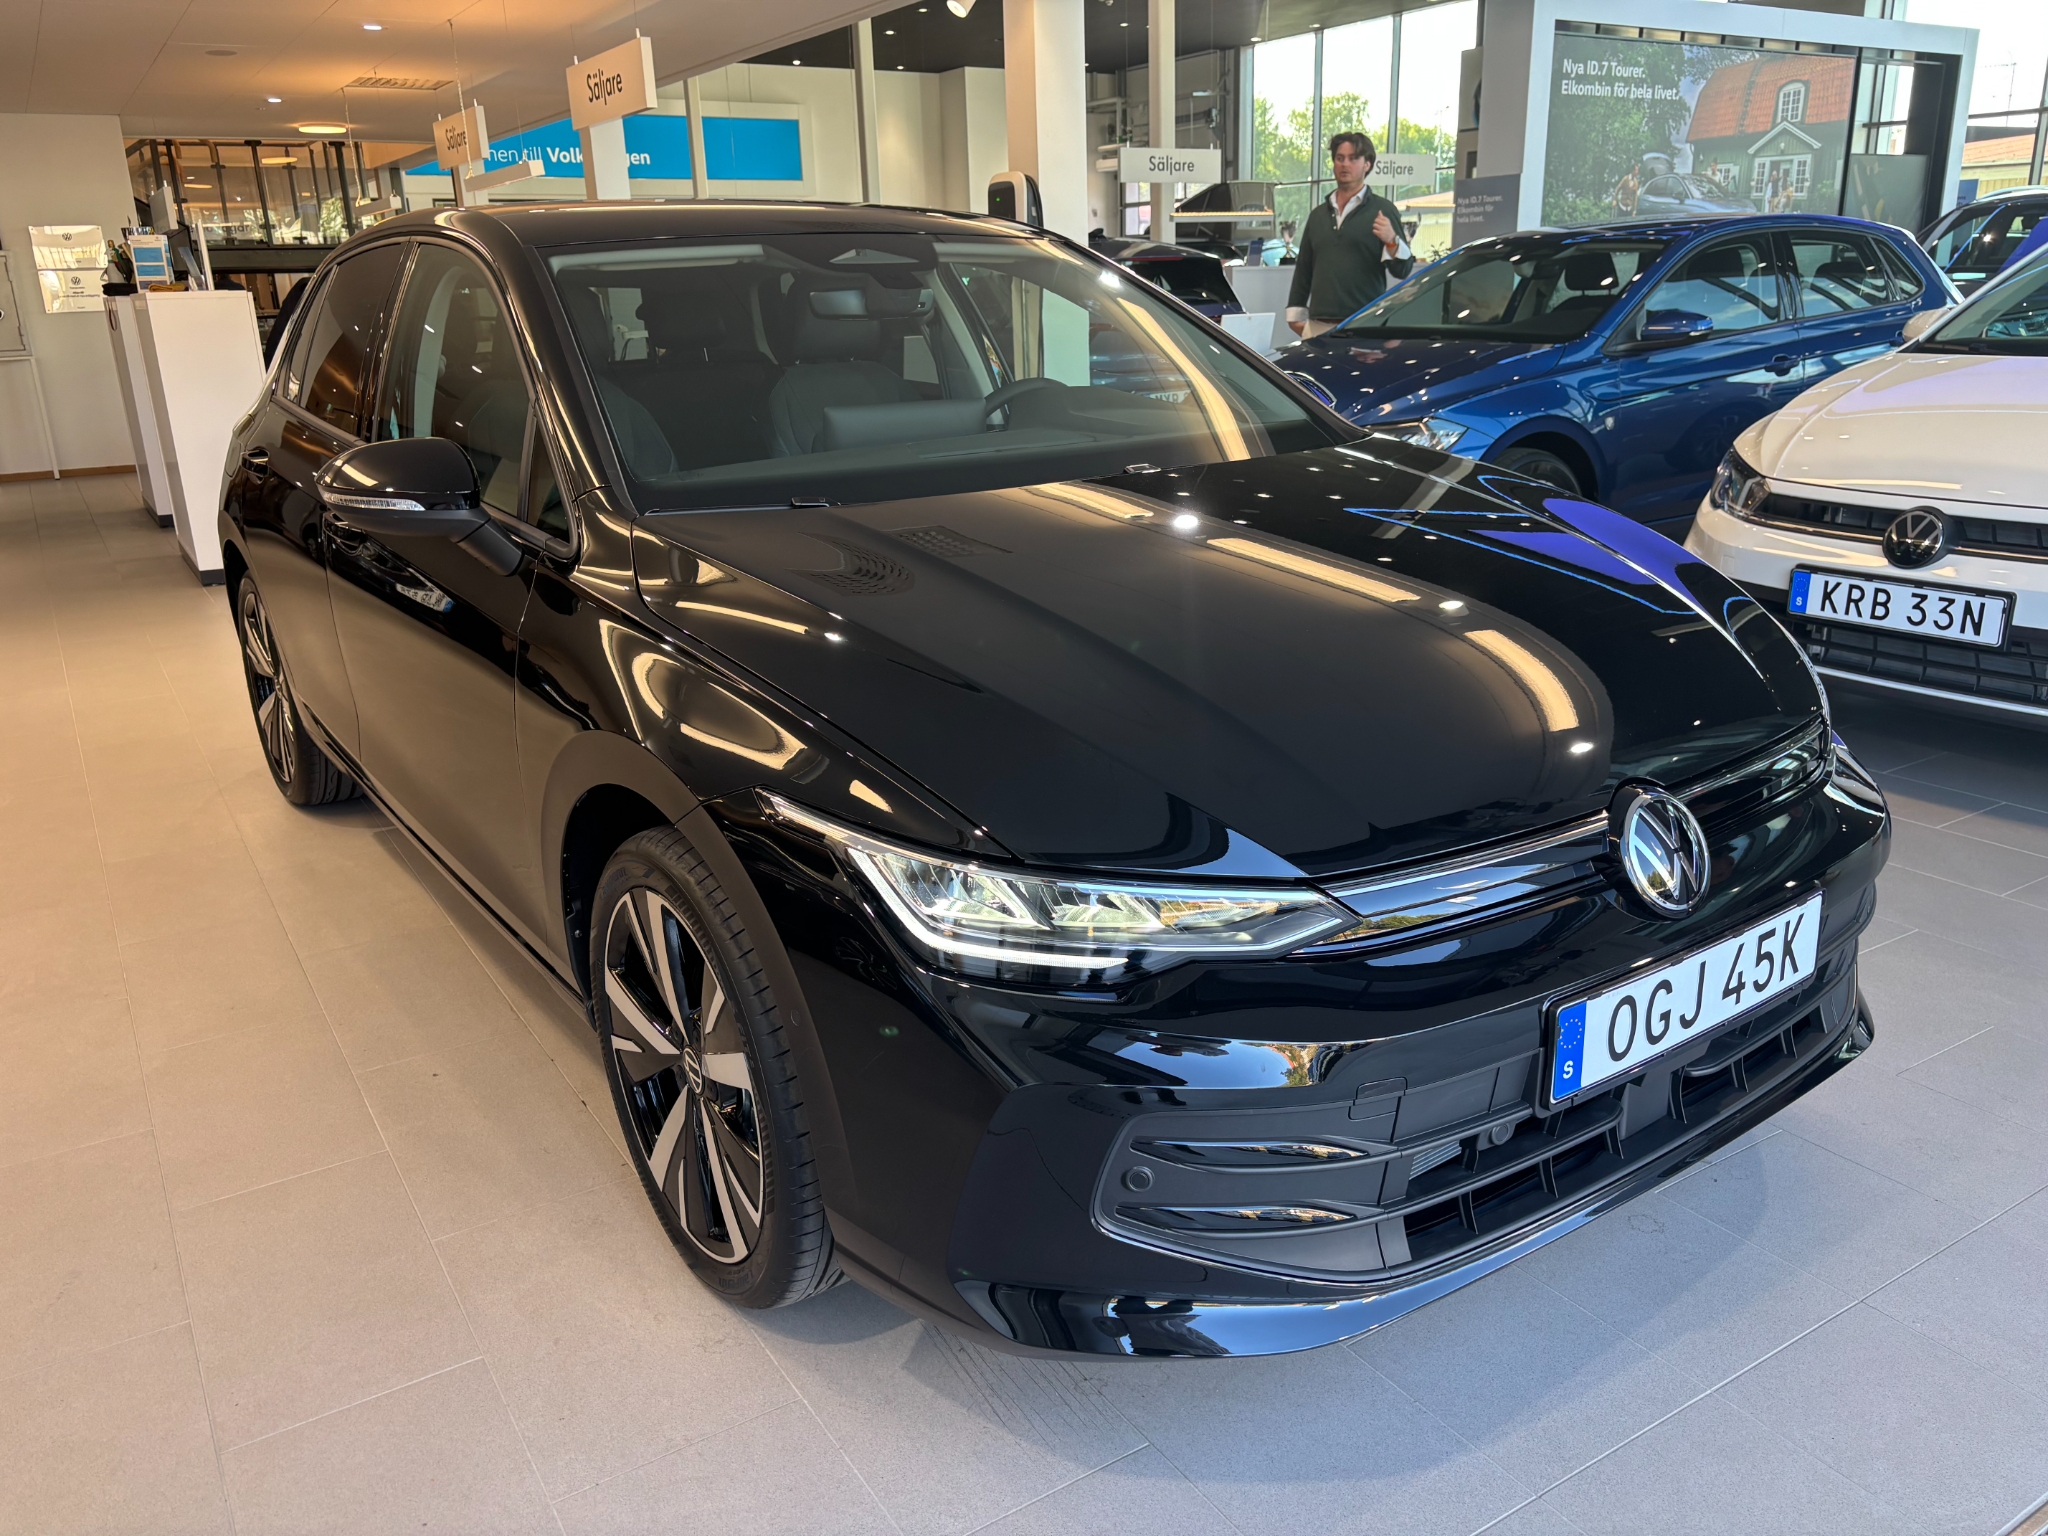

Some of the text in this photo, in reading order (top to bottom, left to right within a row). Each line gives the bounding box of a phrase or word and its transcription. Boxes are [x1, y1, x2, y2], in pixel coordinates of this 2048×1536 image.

[1563, 59, 1646, 78] Nya ID.7 Tourer.
[586, 68, 623, 106] Säljare
[1561, 80, 1680, 100] Elkombin för hela livet.
[445, 126, 467, 151] Säljare
[1148, 155, 1195, 175] Säljare
[1375, 160, 1414, 178] Säljare
[1795, 597, 1803, 606] S
[1820, 580, 1986, 637] KRB 33N
[1607, 912, 1805, 1063] OGJ 45K
[1562, 1060, 1574, 1079] S
